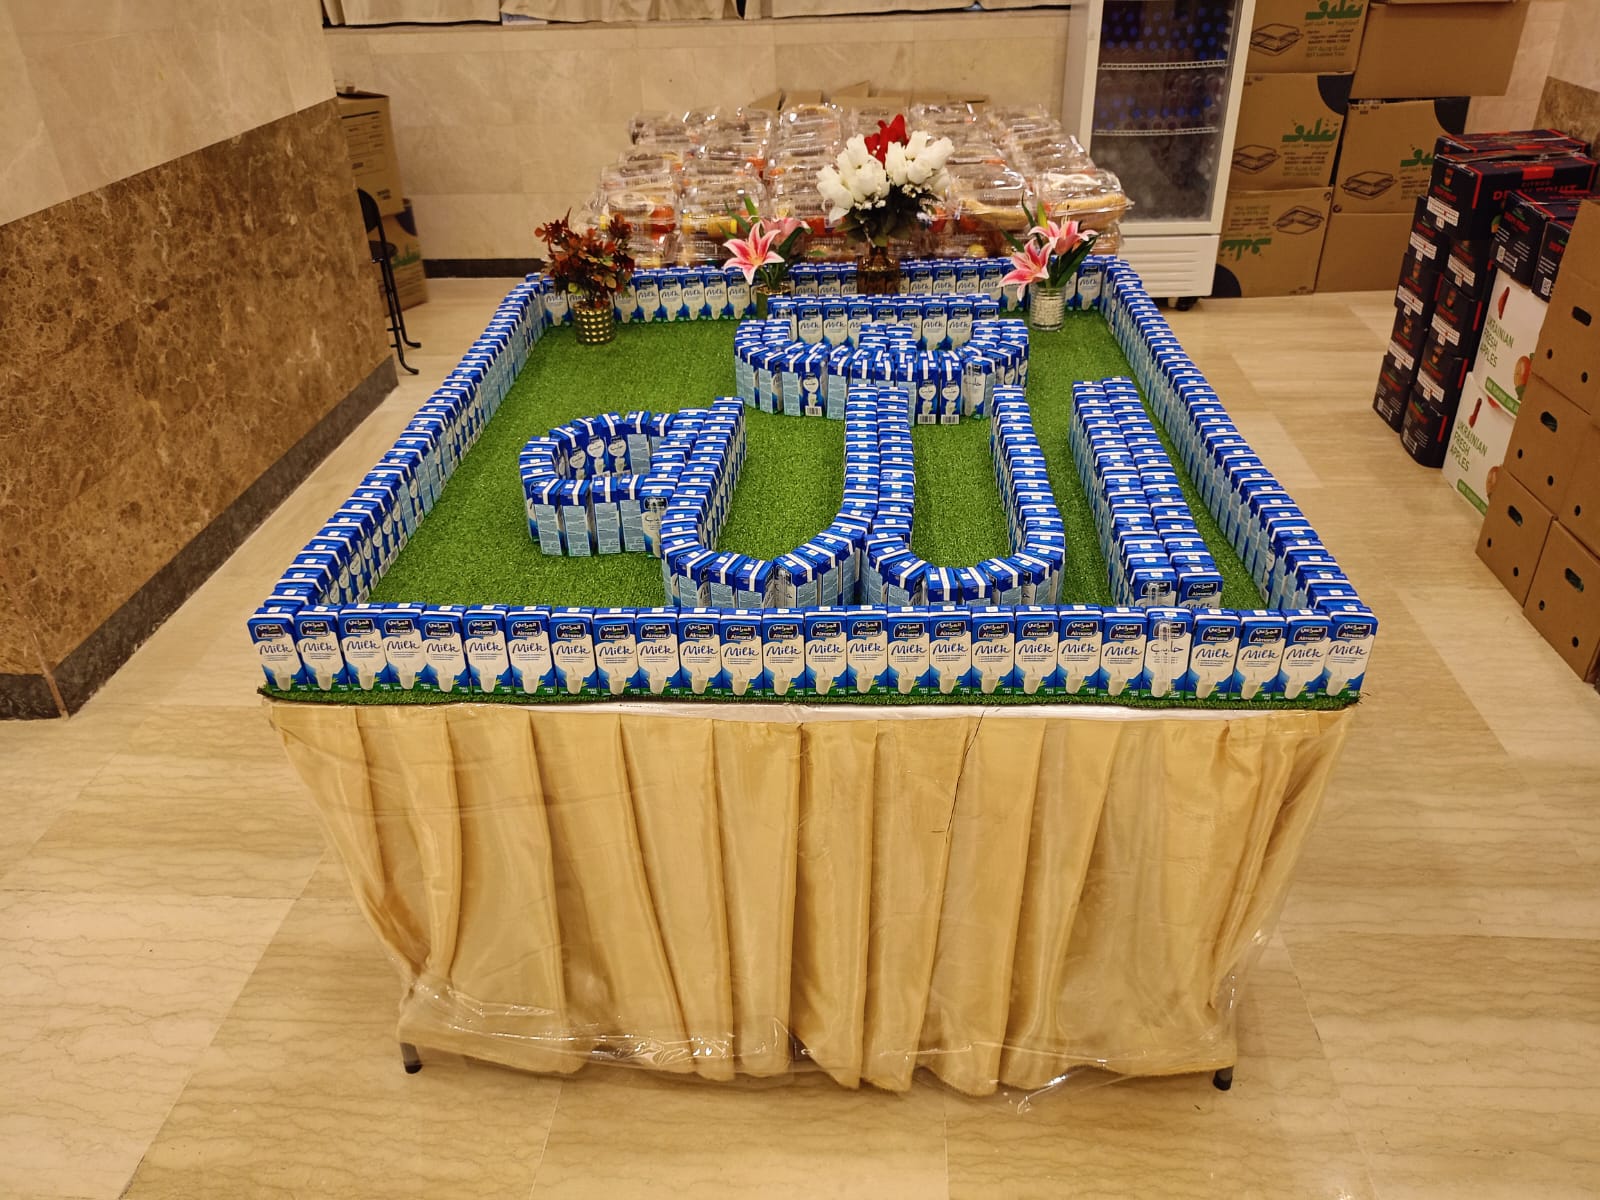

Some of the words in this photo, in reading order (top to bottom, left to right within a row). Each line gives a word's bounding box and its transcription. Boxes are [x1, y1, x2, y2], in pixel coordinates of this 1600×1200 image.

[1455, 431, 1471, 456] FRESH
[1450, 444, 1470, 472] APPLES
[259, 644, 294, 655] Milk
[303, 642, 337, 653] Milk
[346, 640, 381, 651] Milk
[386, 640, 421, 651] Milk
[426, 642, 461, 653] Milk
[469, 641, 503, 653] Milk
[512, 643, 548, 654] Milk
[555, 644, 591, 656] Milk
[599, 645, 635, 657] Milk
[639, 645, 676, 656] Milk
[682, 645, 719, 656] Milk
[766, 645, 802, 657] Milk
[808, 643, 844, 655] Milk
[850, 643, 885, 654] Milk
[890, 644, 928, 656] Milk
[932, 643, 969, 655] Milk
[974, 644, 1011, 656] Milk
[1018, 643, 1056, 655] Milk
[1061, 643, 1099, 655] Milk
[1104, 646, 1143, 657] Milk
[1328, 644, 1368, 655] Milk
[724, 646, 759, 658] Milk
[1195, 648, 1233, 660] Milk
[1241, 649, 1280, 661] Milk
[1286, 648, 1324, 660] Milk
